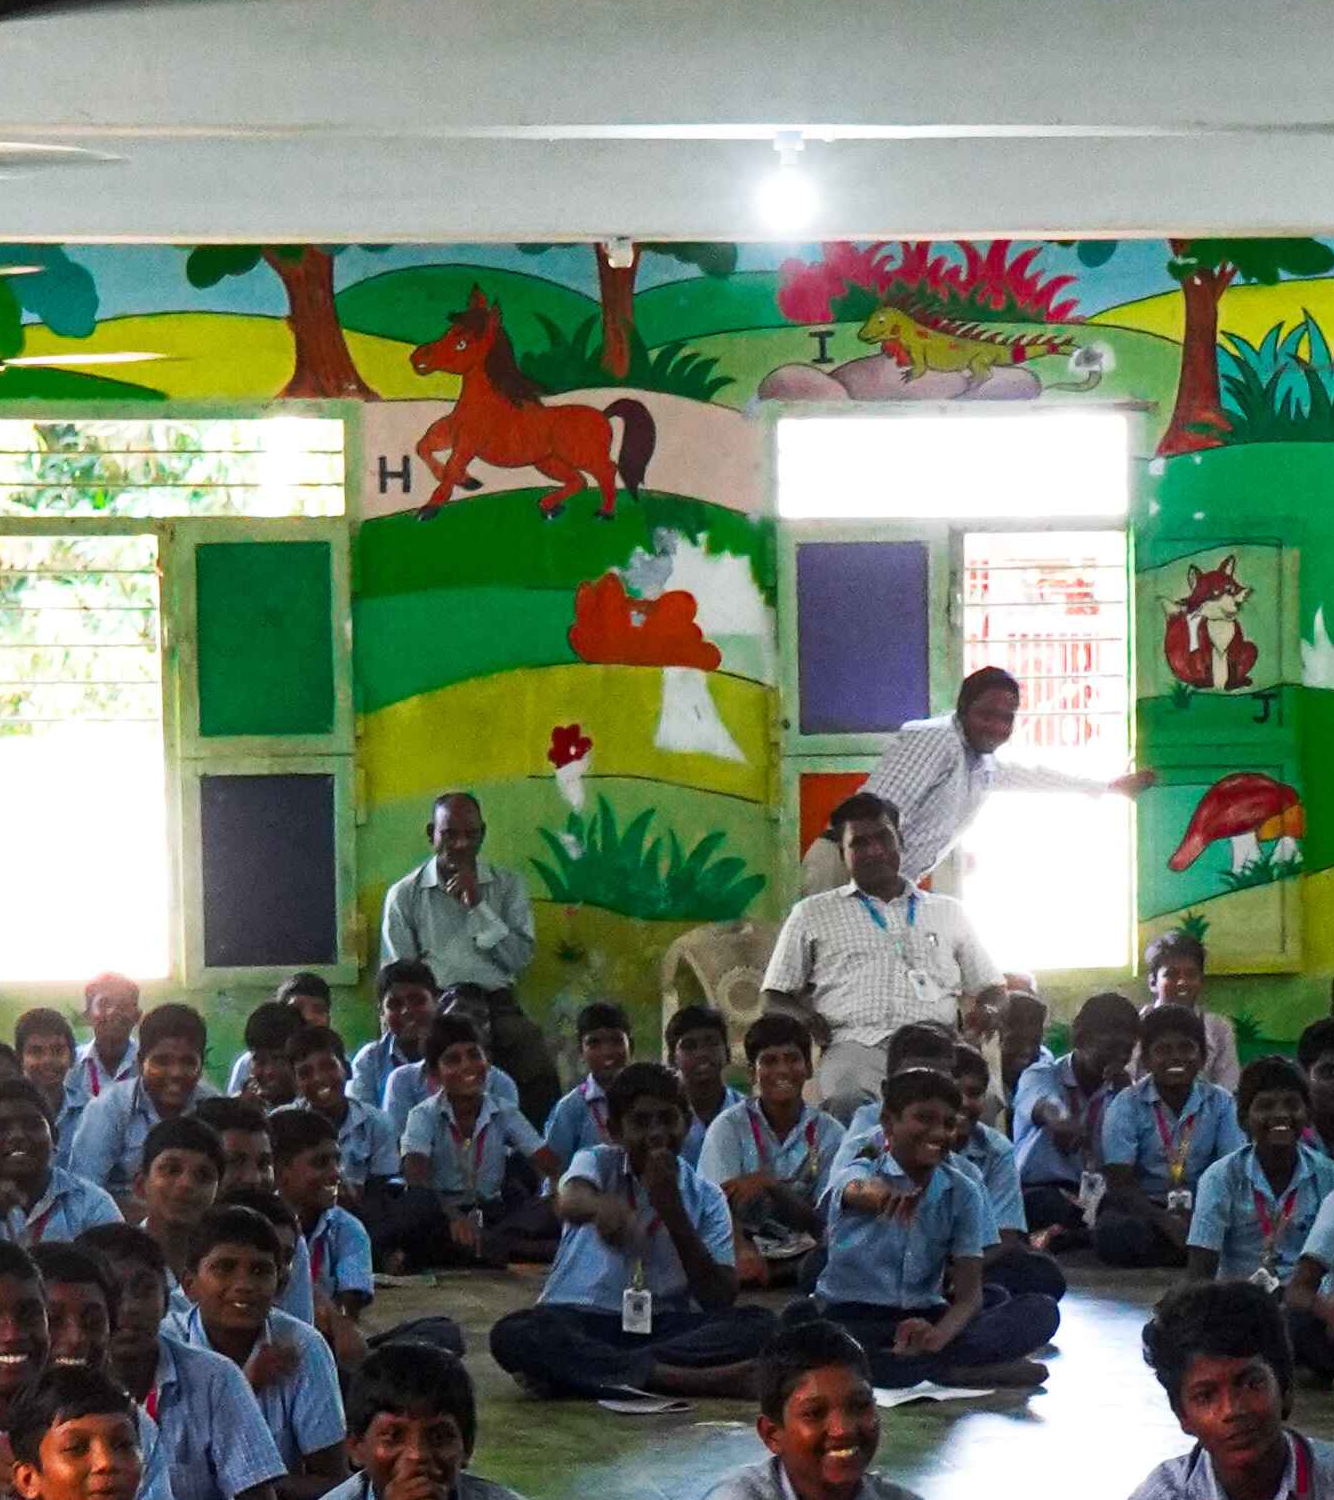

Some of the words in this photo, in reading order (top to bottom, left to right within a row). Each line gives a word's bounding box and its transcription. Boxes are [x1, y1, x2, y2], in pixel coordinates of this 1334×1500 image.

[808, 330, 836, 364] I
[378, 455, 412, 494] H
[1251, 691, 1278, 724] J
